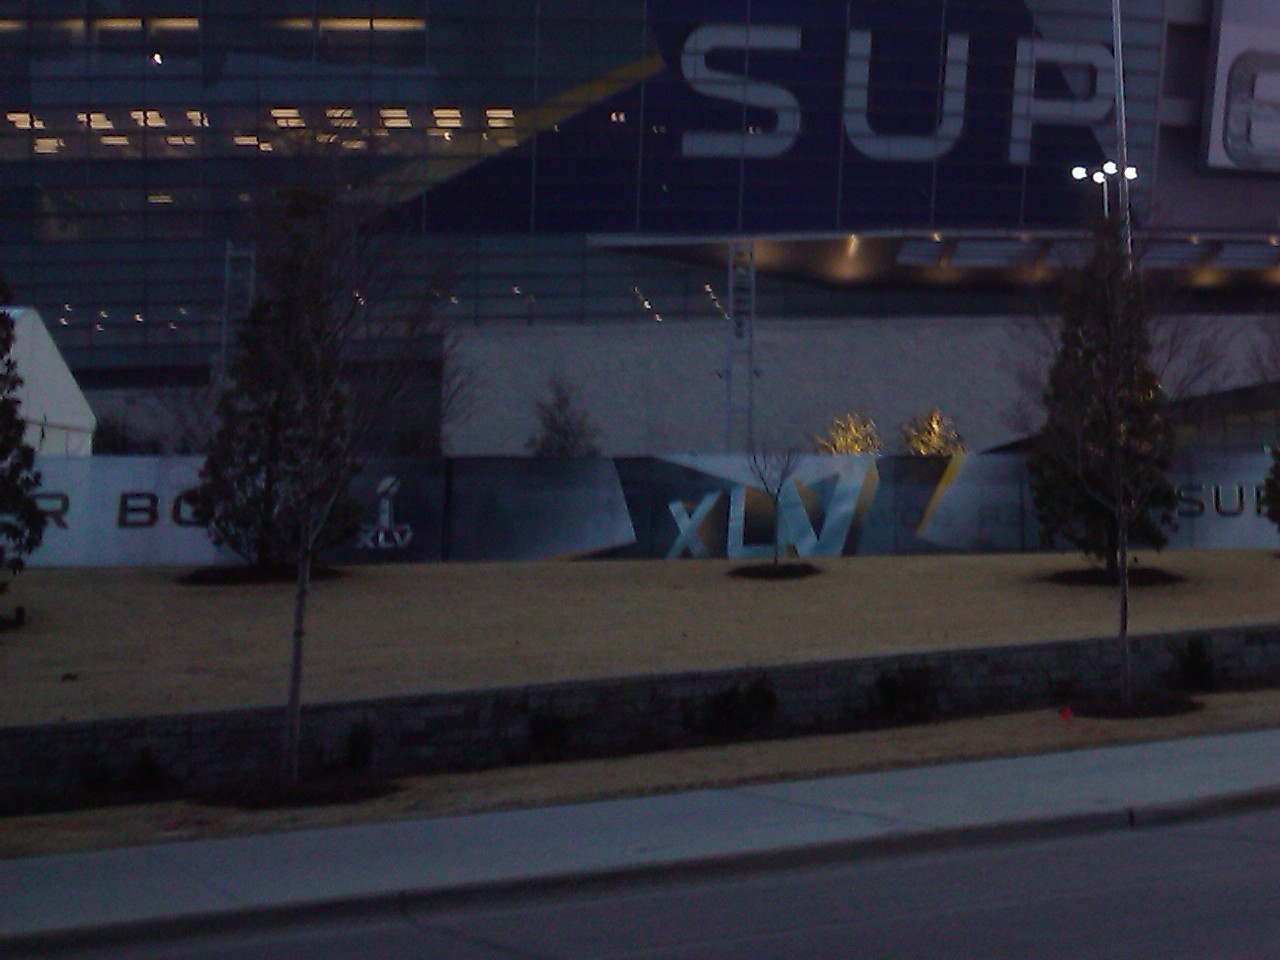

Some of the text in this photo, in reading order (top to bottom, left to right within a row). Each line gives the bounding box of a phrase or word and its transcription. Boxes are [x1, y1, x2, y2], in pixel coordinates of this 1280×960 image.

[117, 491, 207, 529] BO
[662, 458, 872, 559] XLV
[356, 524, 413, 550] XLV
